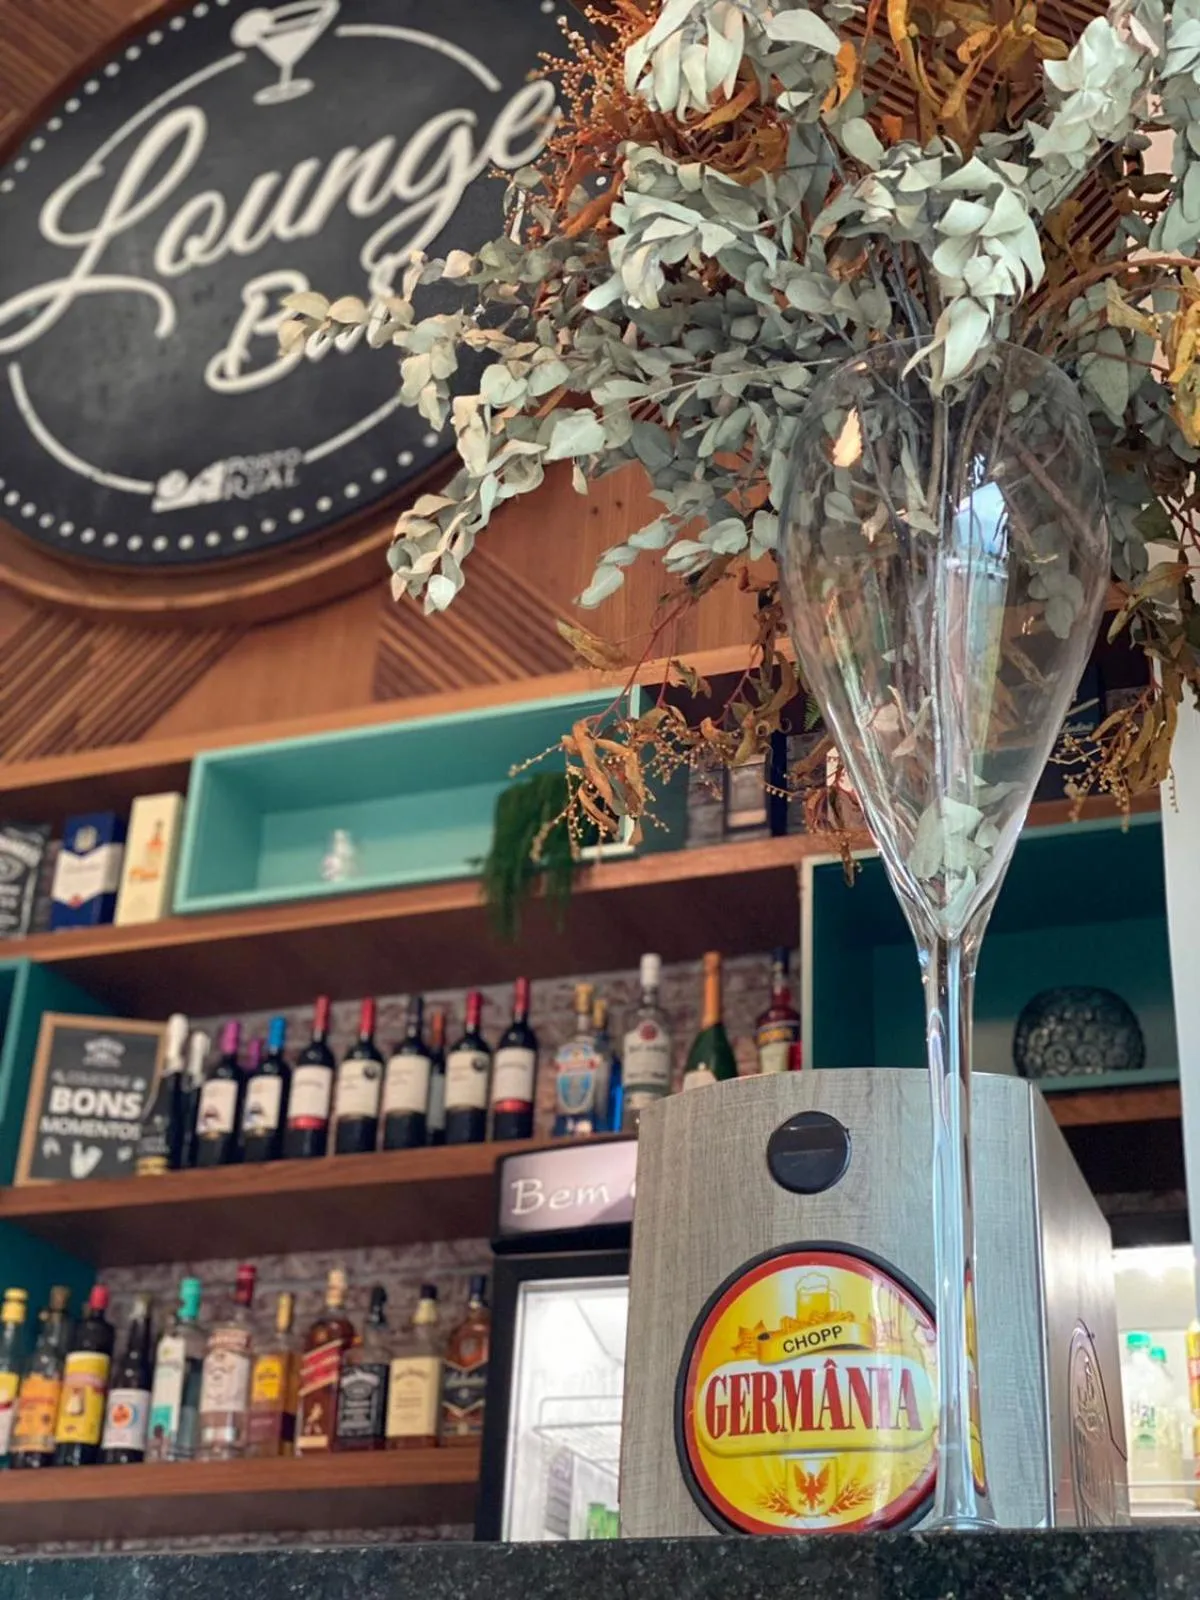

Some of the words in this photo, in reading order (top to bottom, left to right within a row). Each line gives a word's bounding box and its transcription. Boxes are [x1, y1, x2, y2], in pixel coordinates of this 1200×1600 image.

[0, 80, 561, 353] Lounge
[49, 1085, 143, 1120] BONS
[510, 1178, 610, 1215] Bem
[782, 1324, 843, 1354] CHOPP
[704, 1357, 924, 1440] GERMÂNIA
